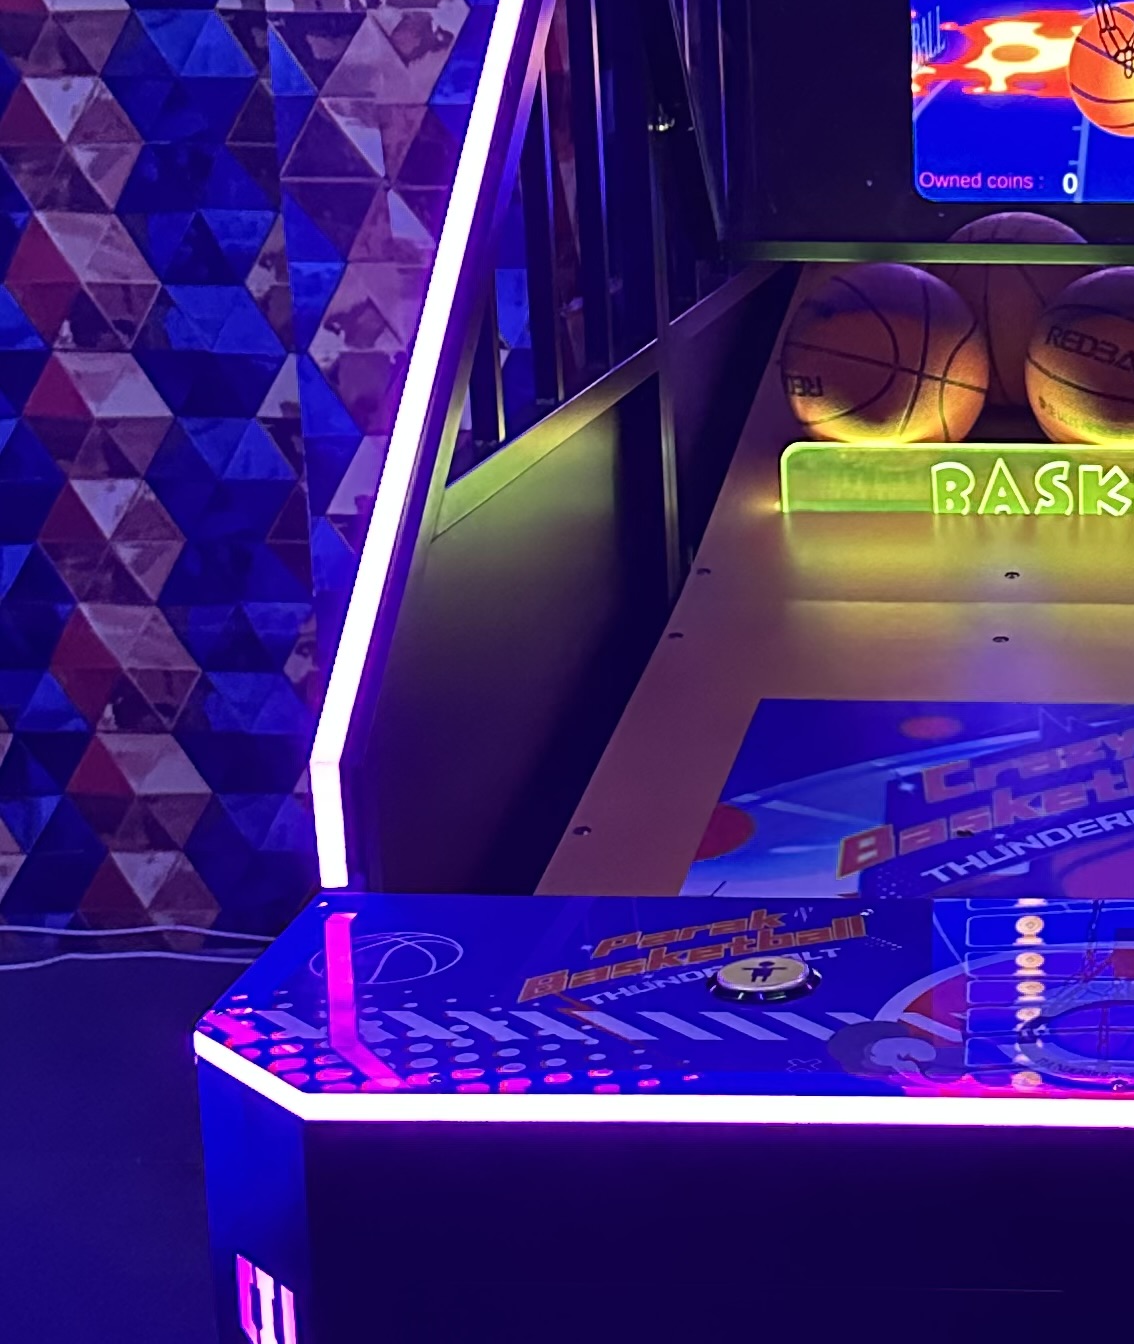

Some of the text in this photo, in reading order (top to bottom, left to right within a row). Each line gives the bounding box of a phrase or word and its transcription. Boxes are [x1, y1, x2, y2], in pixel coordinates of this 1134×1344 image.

[919, 172, 982, 190] Owned
[986, 173, 1034, 190] coins
[1062, 173, 1079, 195] 0
[516, 914, 867, 1004] Basketball
[591, 908, 788, 960] Parak
